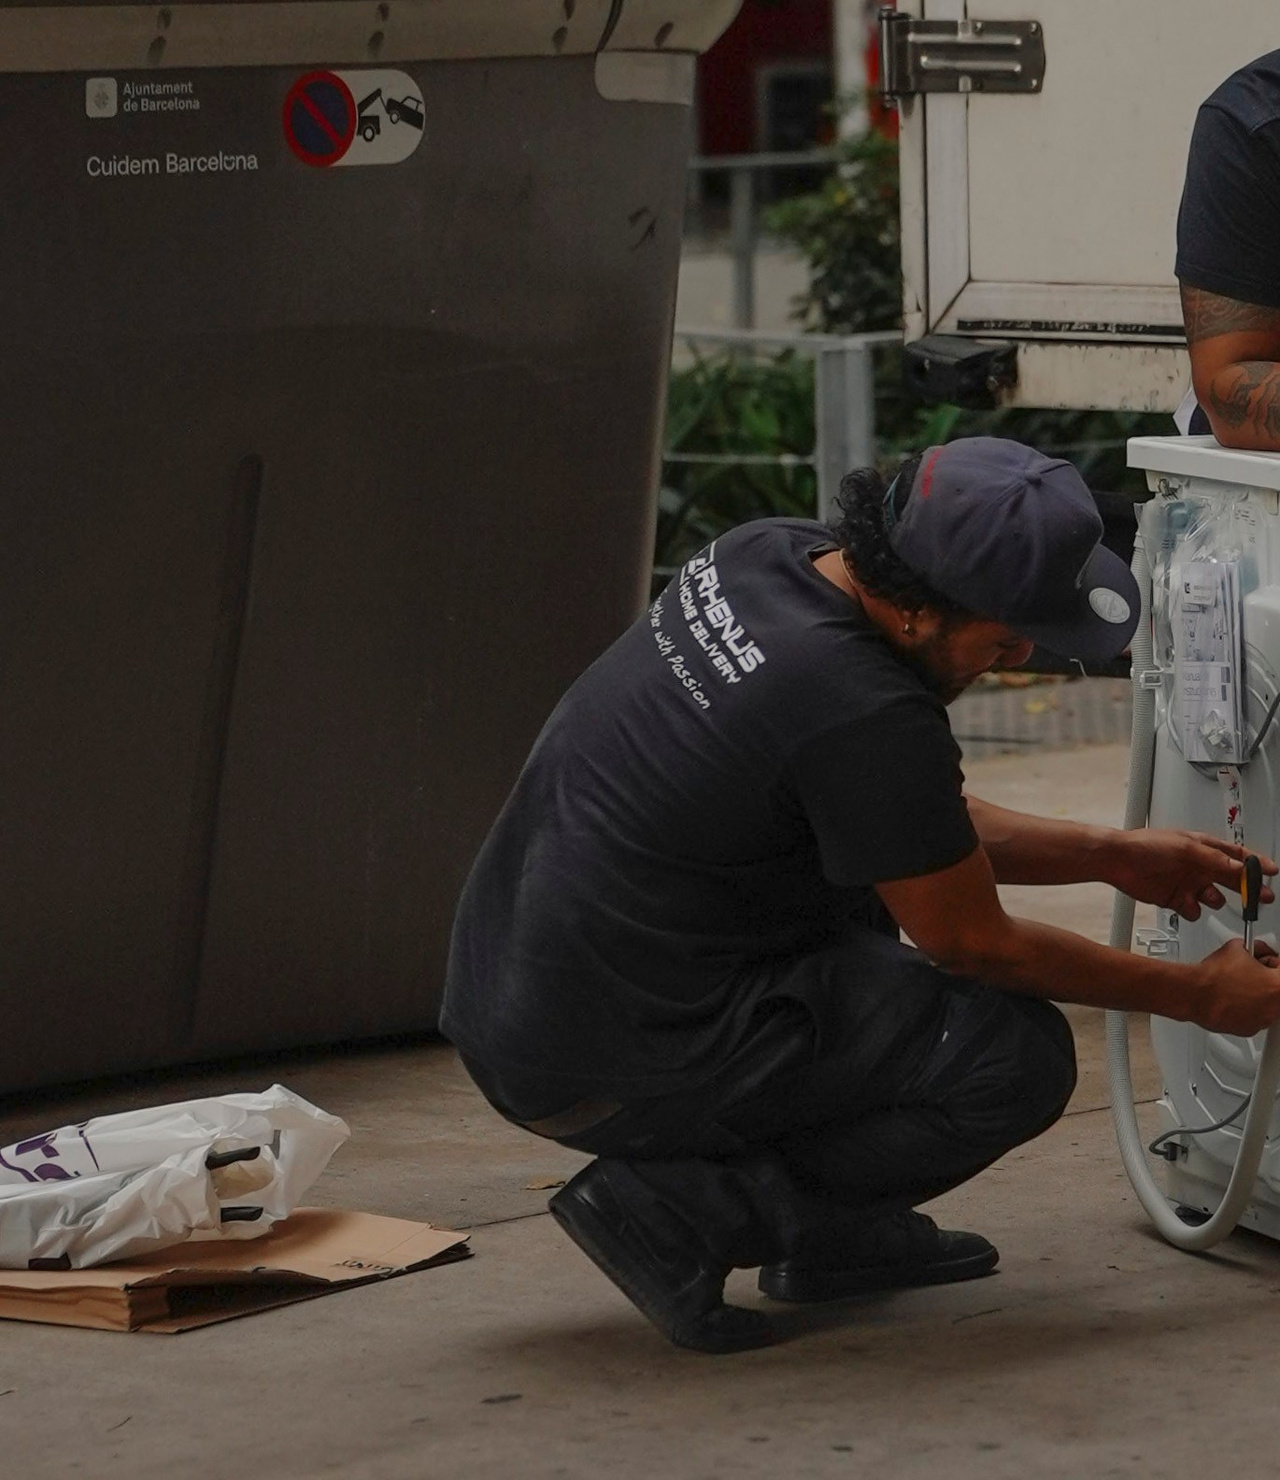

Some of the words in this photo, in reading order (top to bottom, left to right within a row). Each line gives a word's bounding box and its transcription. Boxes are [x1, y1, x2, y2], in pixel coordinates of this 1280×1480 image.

[122, 80, 194, 98] Ajuntament
[122, 99, 139, 113] de
[141, 97, 201, 113] Barcelona
[86, 154, 160, 177] Cuidem
[166, 150, 259, 174] Barcelona
[679, 580, 699, 621] HOME
[689, 619, 742, 684] DELIVERY
[693, 564, 767, 673] RHENUS
[654, 630, 676, 657] with
